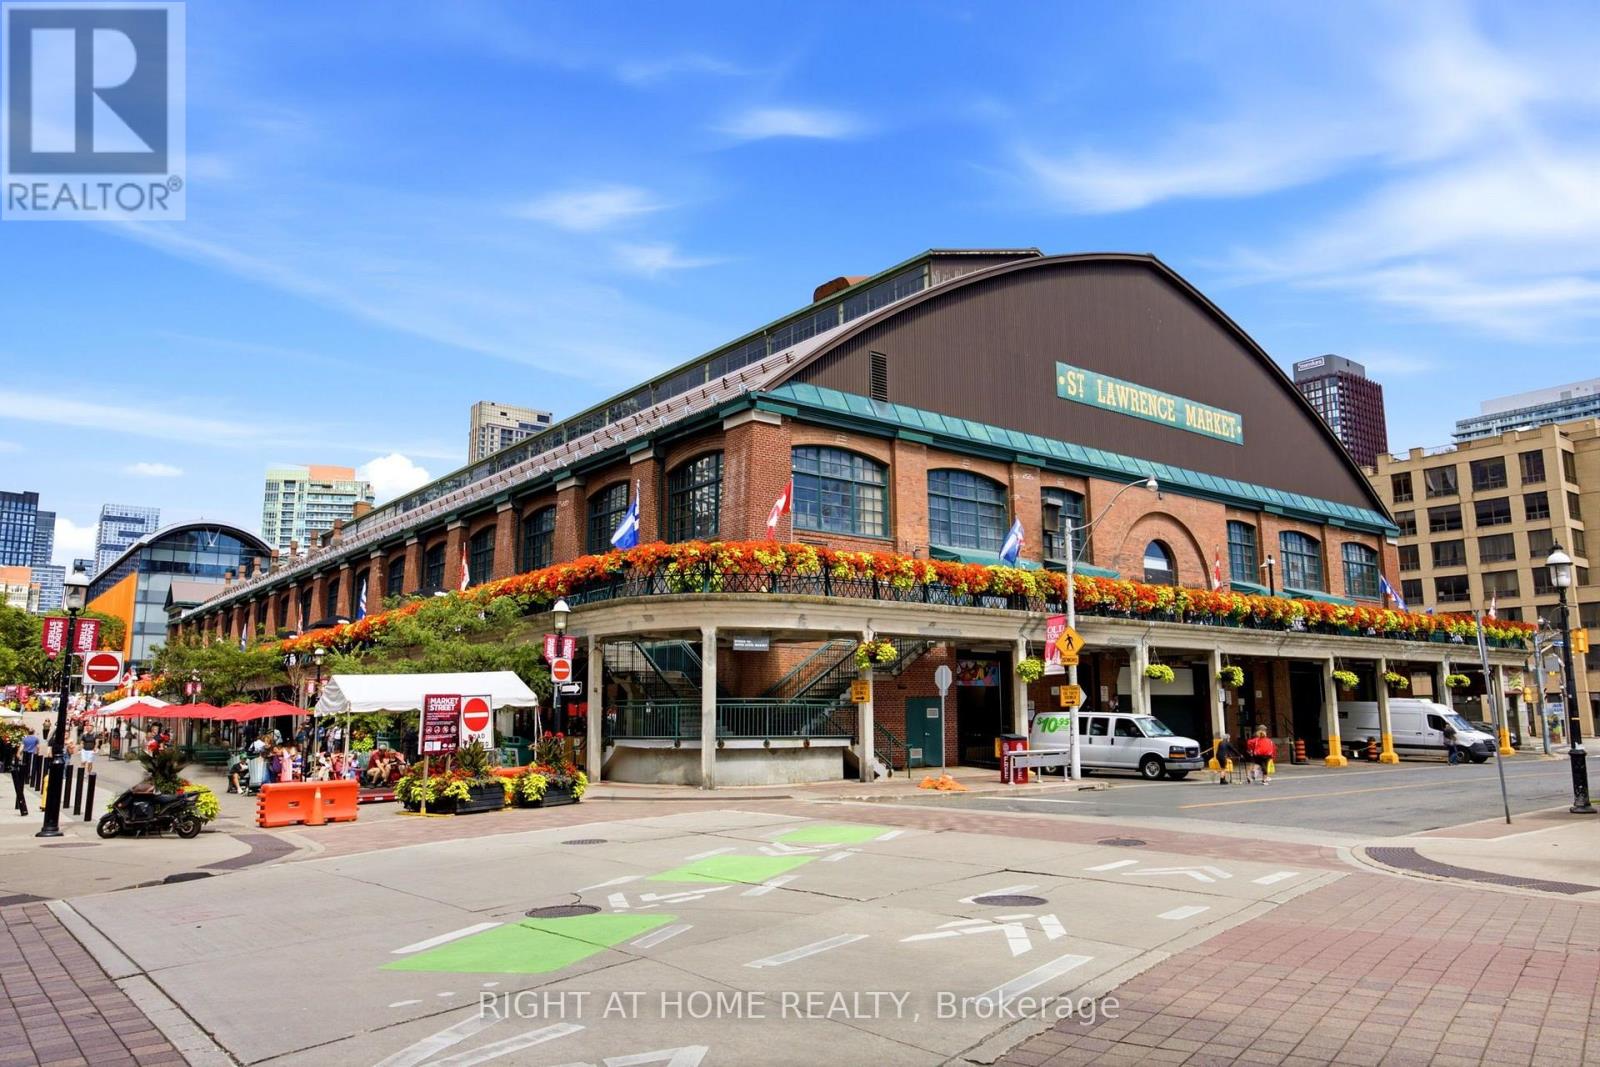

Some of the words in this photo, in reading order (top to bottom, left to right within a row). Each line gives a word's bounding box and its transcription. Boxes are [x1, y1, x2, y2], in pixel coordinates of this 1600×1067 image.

[1097, 379, 1175, 422] LAWRENCE
[1185, 405, 1236, 438] MARKET
[47, 621, 56, 649] STREET
[54, 621, 64, 652] MARKET
[78, 623, 88, 650] STREET
[86, 622, 96, 652] MARKET
[430, 697, 459, 705] MARKET
